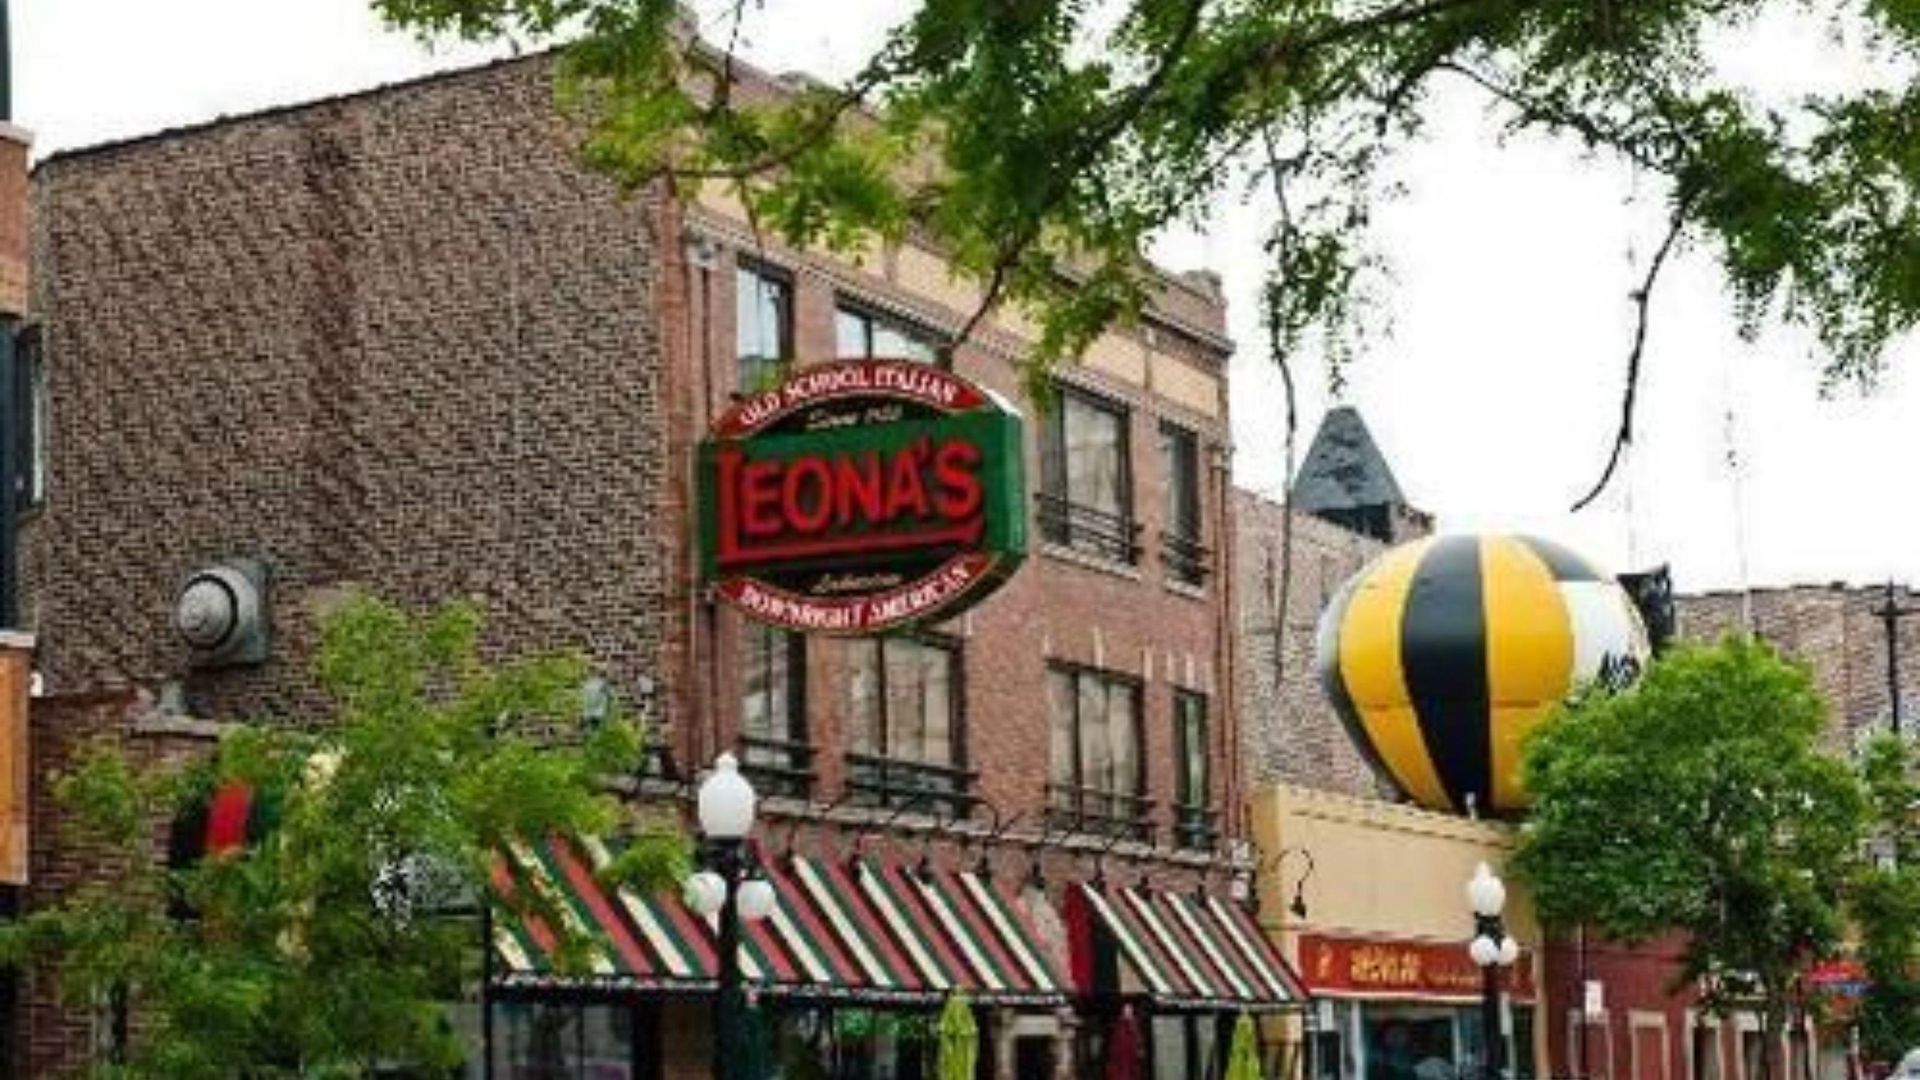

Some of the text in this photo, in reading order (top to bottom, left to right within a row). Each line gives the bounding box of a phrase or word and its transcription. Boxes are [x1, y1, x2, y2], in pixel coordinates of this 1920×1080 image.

[740, 366, 958, 425] OLD SCHOOL ITALIAN
[717, 436, 983, 564] LEONA'S
[741, 562, 969, 628] DOWNRIGHT AMERICAN
